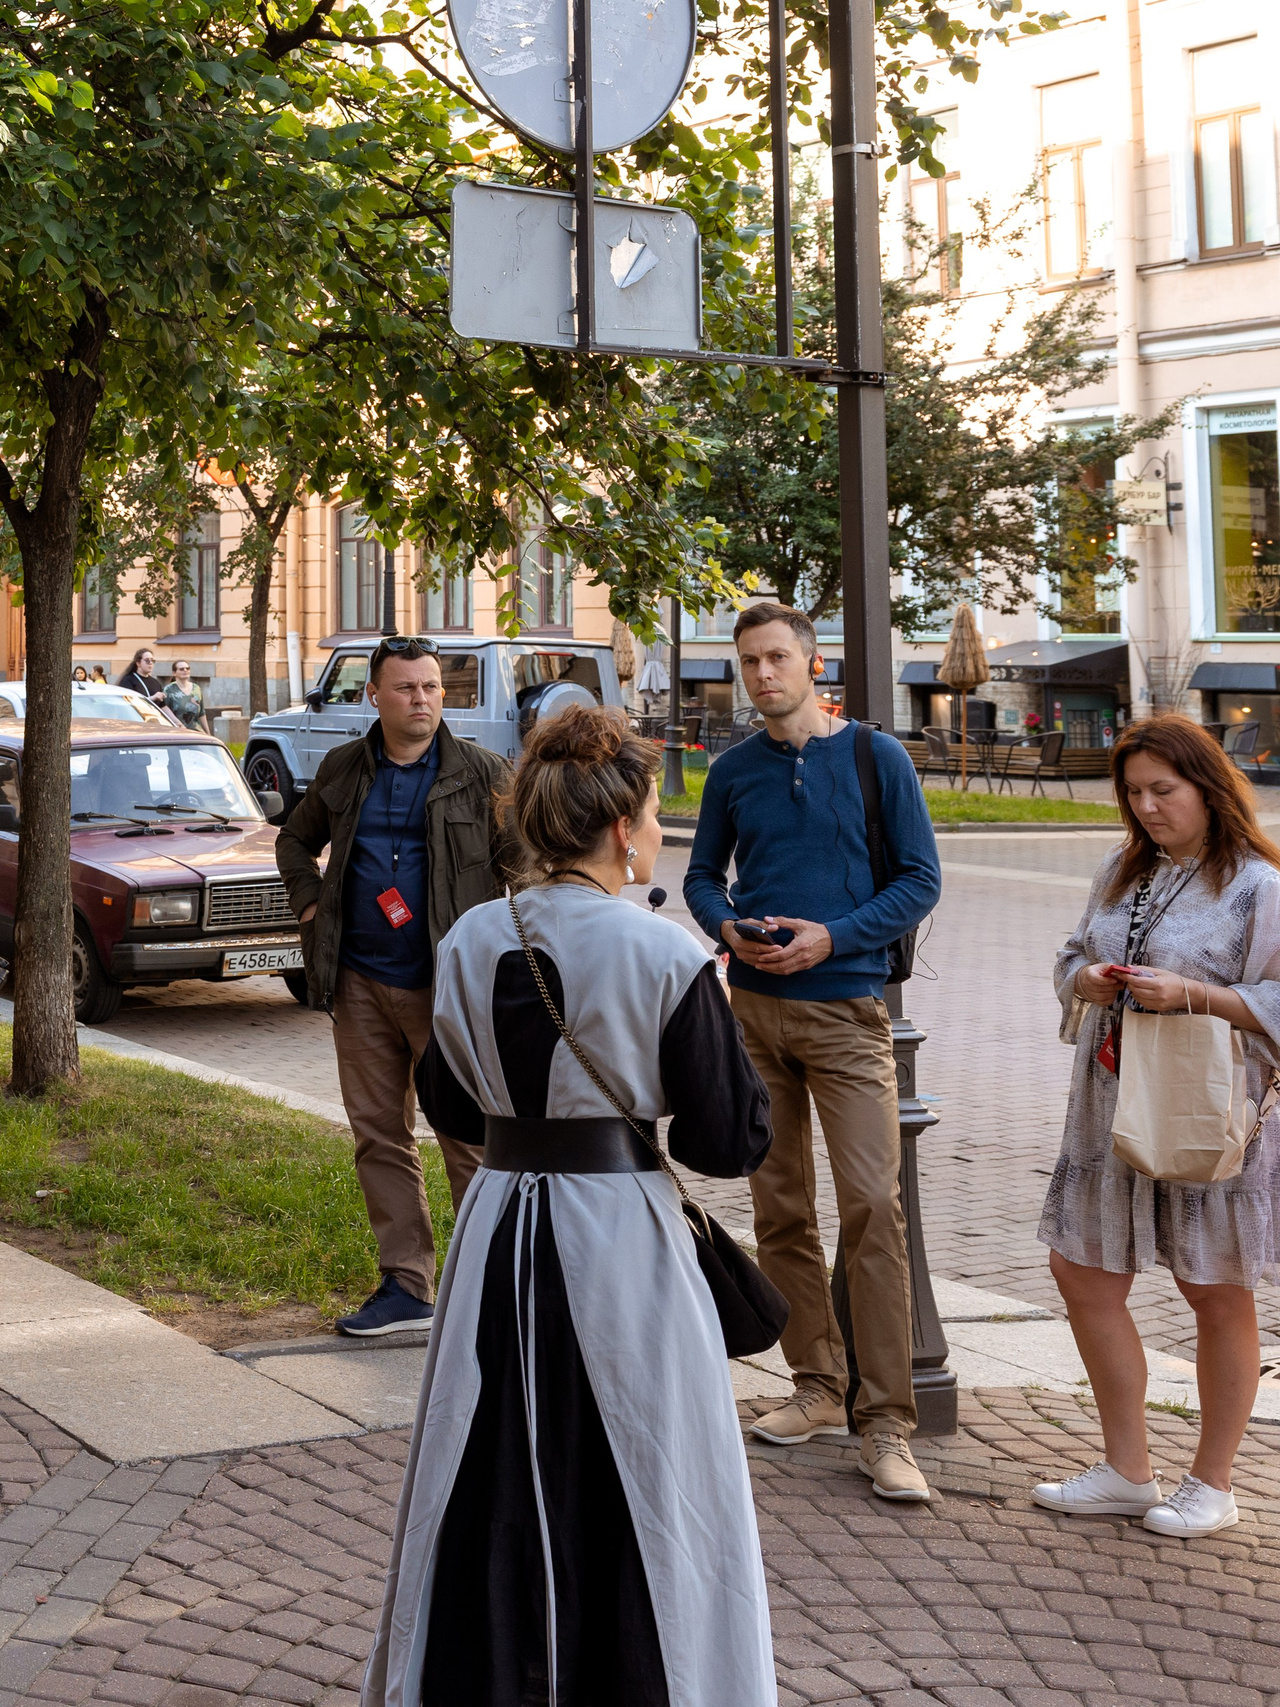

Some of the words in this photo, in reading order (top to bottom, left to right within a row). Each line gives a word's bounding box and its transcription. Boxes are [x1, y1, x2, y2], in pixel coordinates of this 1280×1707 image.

[1224, 408, 1271, 418] АППАРАТНАЯ
[1219, 418, 1276, 429] КОСМЕТОЛОГИЯ
[1147, 491, 1161, 500] БАР
